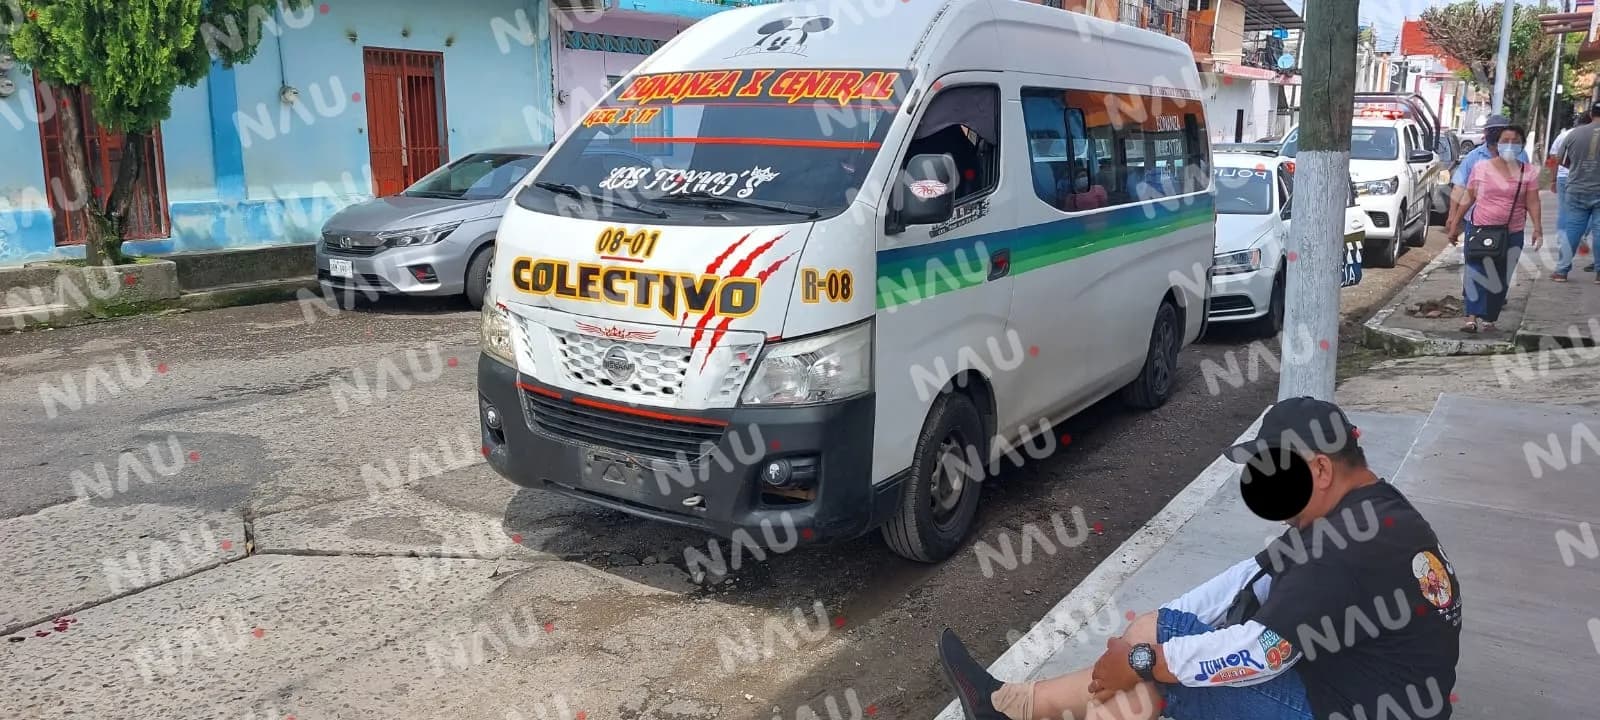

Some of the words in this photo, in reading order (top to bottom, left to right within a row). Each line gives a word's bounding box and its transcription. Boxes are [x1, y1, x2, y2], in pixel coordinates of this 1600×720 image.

[617, 71, 742, 105] BONANZA
[736, 70, 775, 97] X
[769, 70, 900, 106] CENTRAL
[595, 226, 663, 259] 08-01
[512, 255, 762, 321] COLECTIVO
[801, 267, 854, 304] R-08
